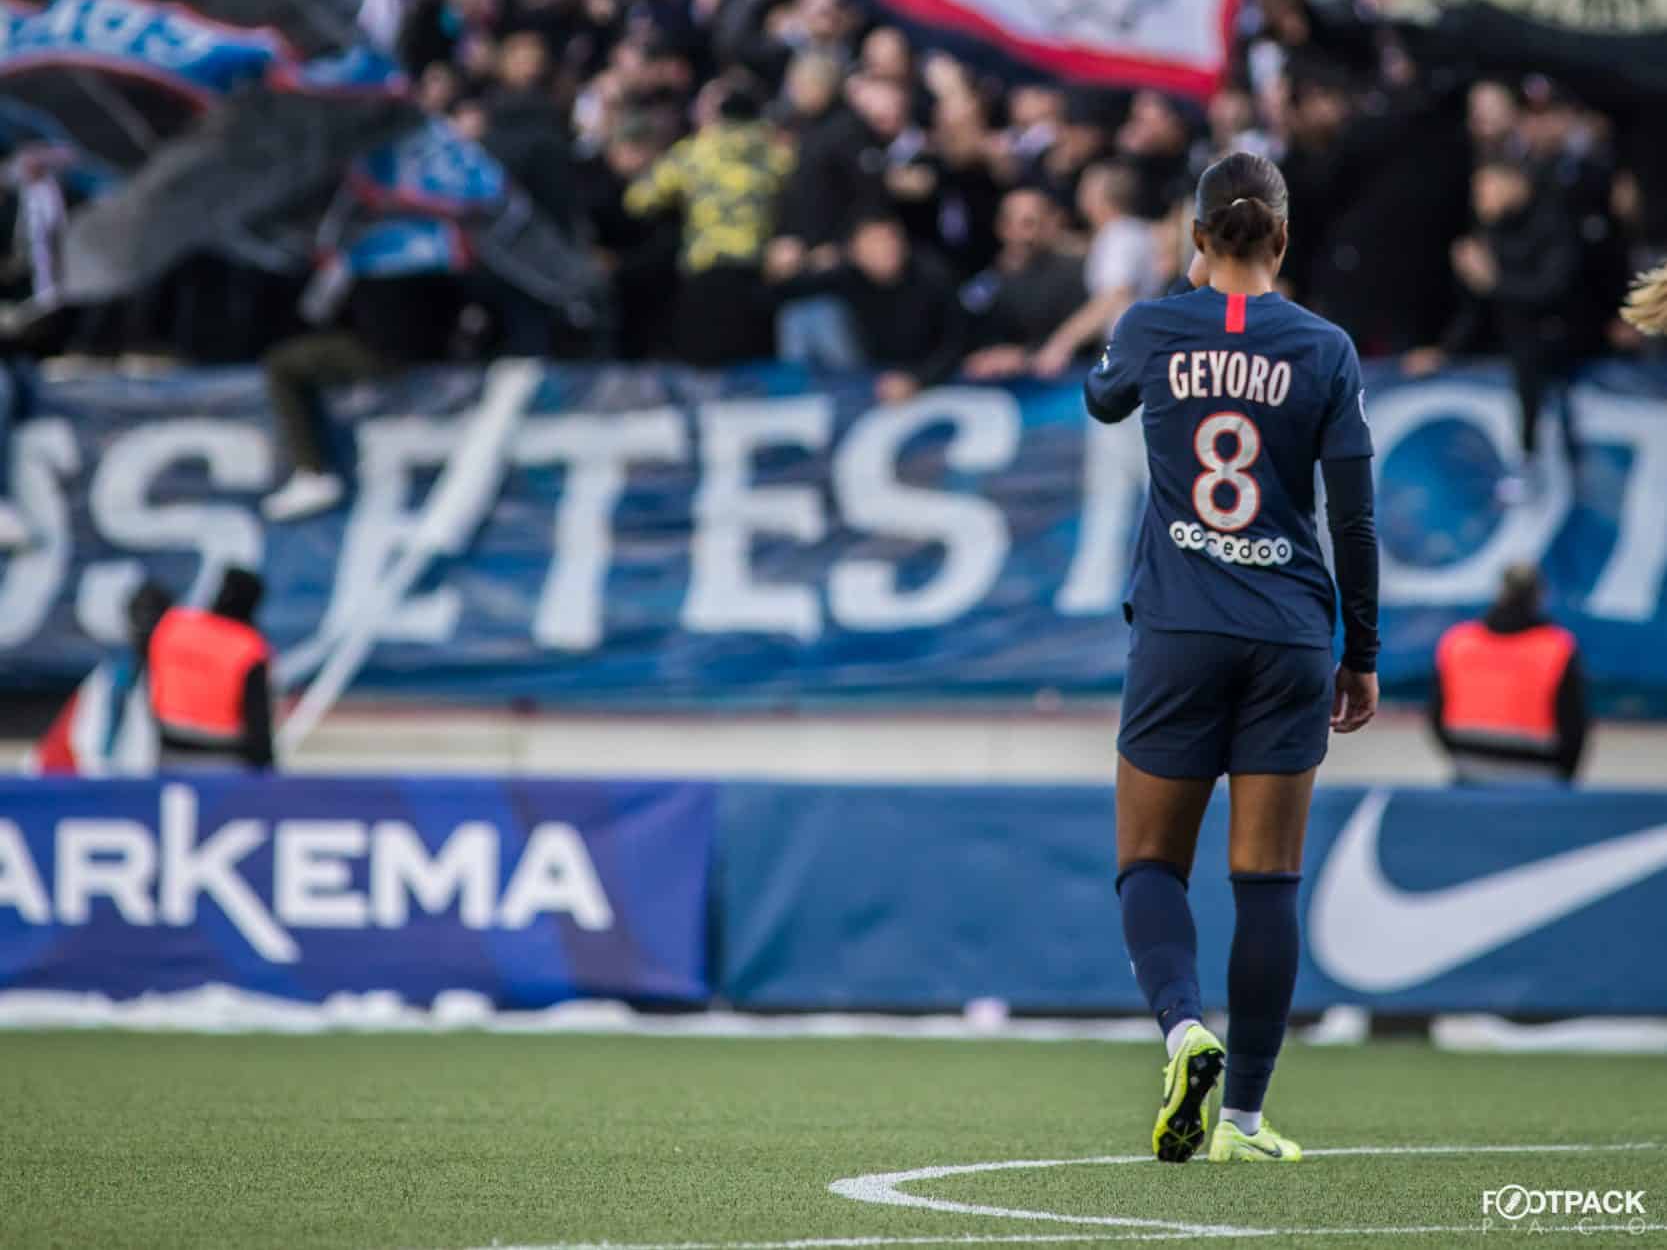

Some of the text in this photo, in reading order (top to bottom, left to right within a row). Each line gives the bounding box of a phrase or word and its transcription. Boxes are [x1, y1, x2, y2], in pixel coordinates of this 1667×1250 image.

[1168, 350, 1292, 407] GEYORO
[1192, 410, 1261, 532] 8
[1171, 523, 1290, 564] ooredoo
